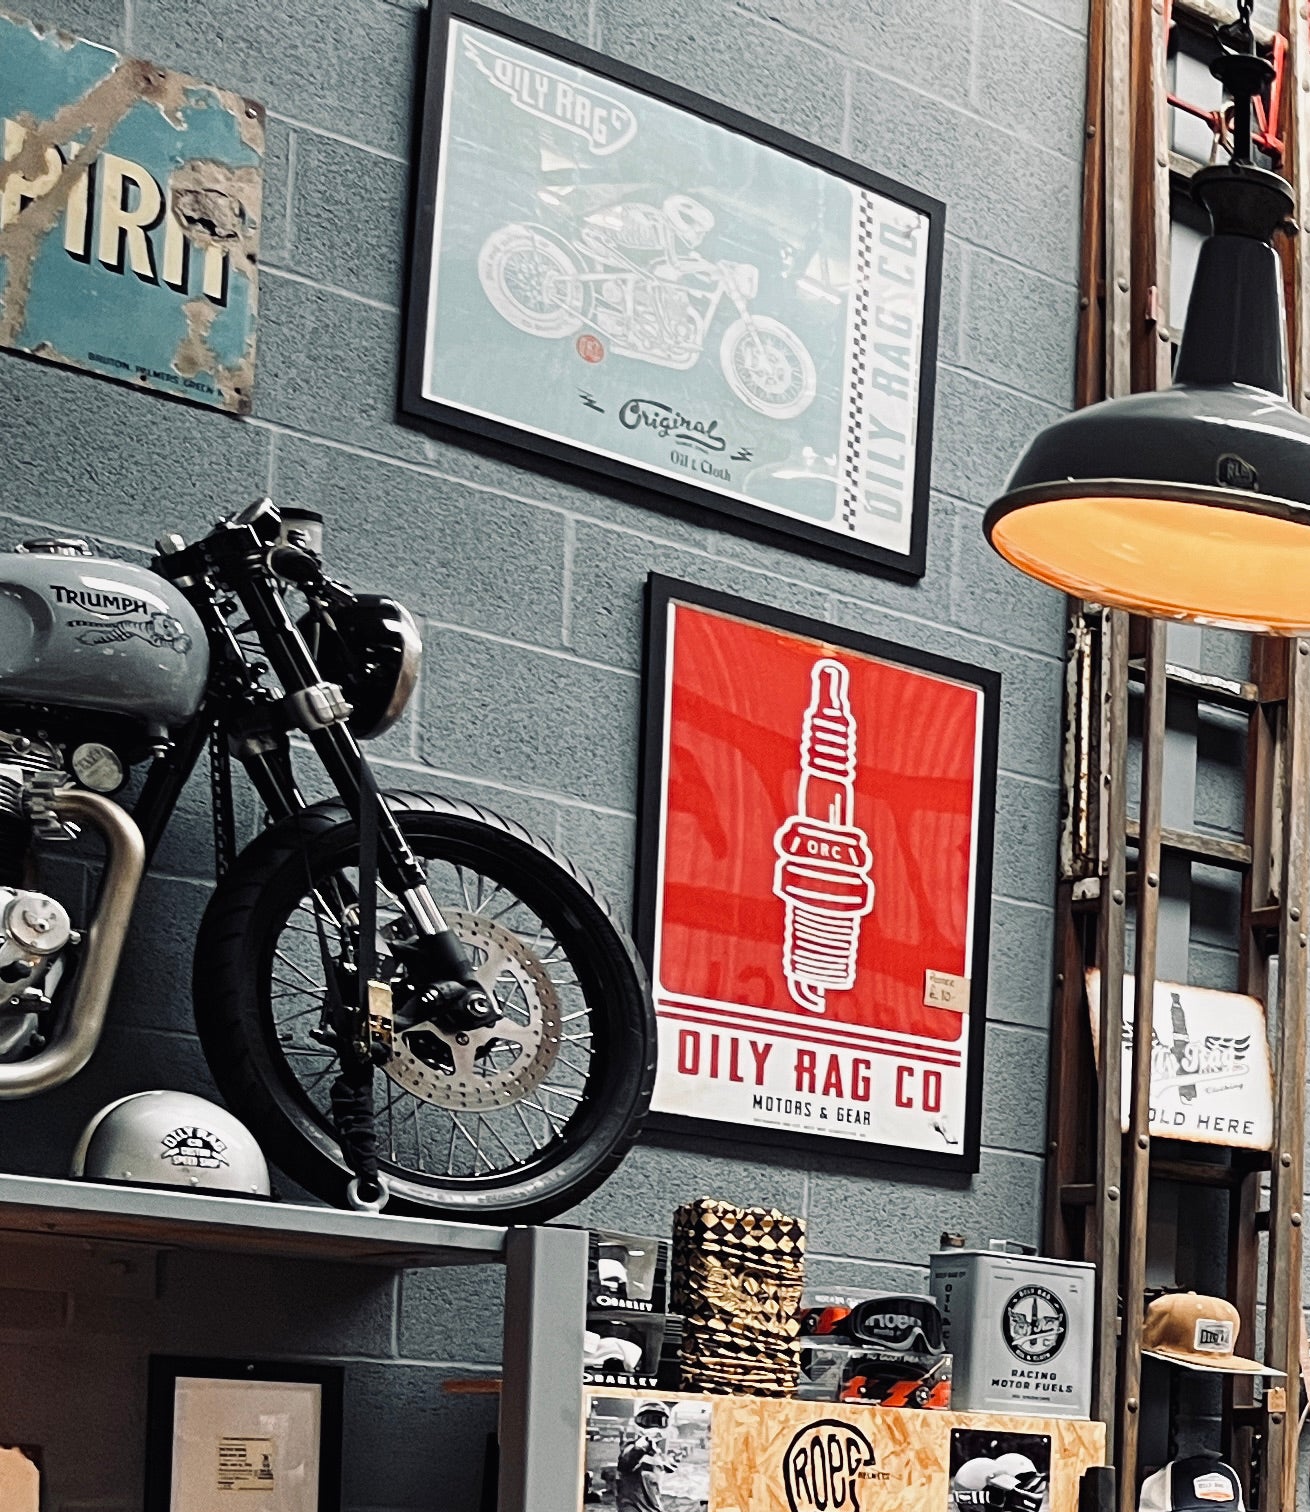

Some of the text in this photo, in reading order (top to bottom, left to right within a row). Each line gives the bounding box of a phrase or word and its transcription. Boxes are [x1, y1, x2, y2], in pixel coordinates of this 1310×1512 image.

[493, 57, 551, 106] OILY
[555, 83, 608, 146] RAG
[618, 399, 727, 451] Original
[670, 450, 690, 470] Oil
[700, 459, 732, 483] Cloth
[50, 585, 148, 615] TRIUMPH
[807, 839, 843, 861] ORC
[677, 1029, 943, 1113] OILY RAG CO
[753, 1094, 872, 1126] MOTORS & GEAR
[1149, 1107, 1256, 1136] OLD HERE
[991, 1379, 1074, 1394] MOTOR FUELS
[1011, 1369, 1057, 1381] RACING
